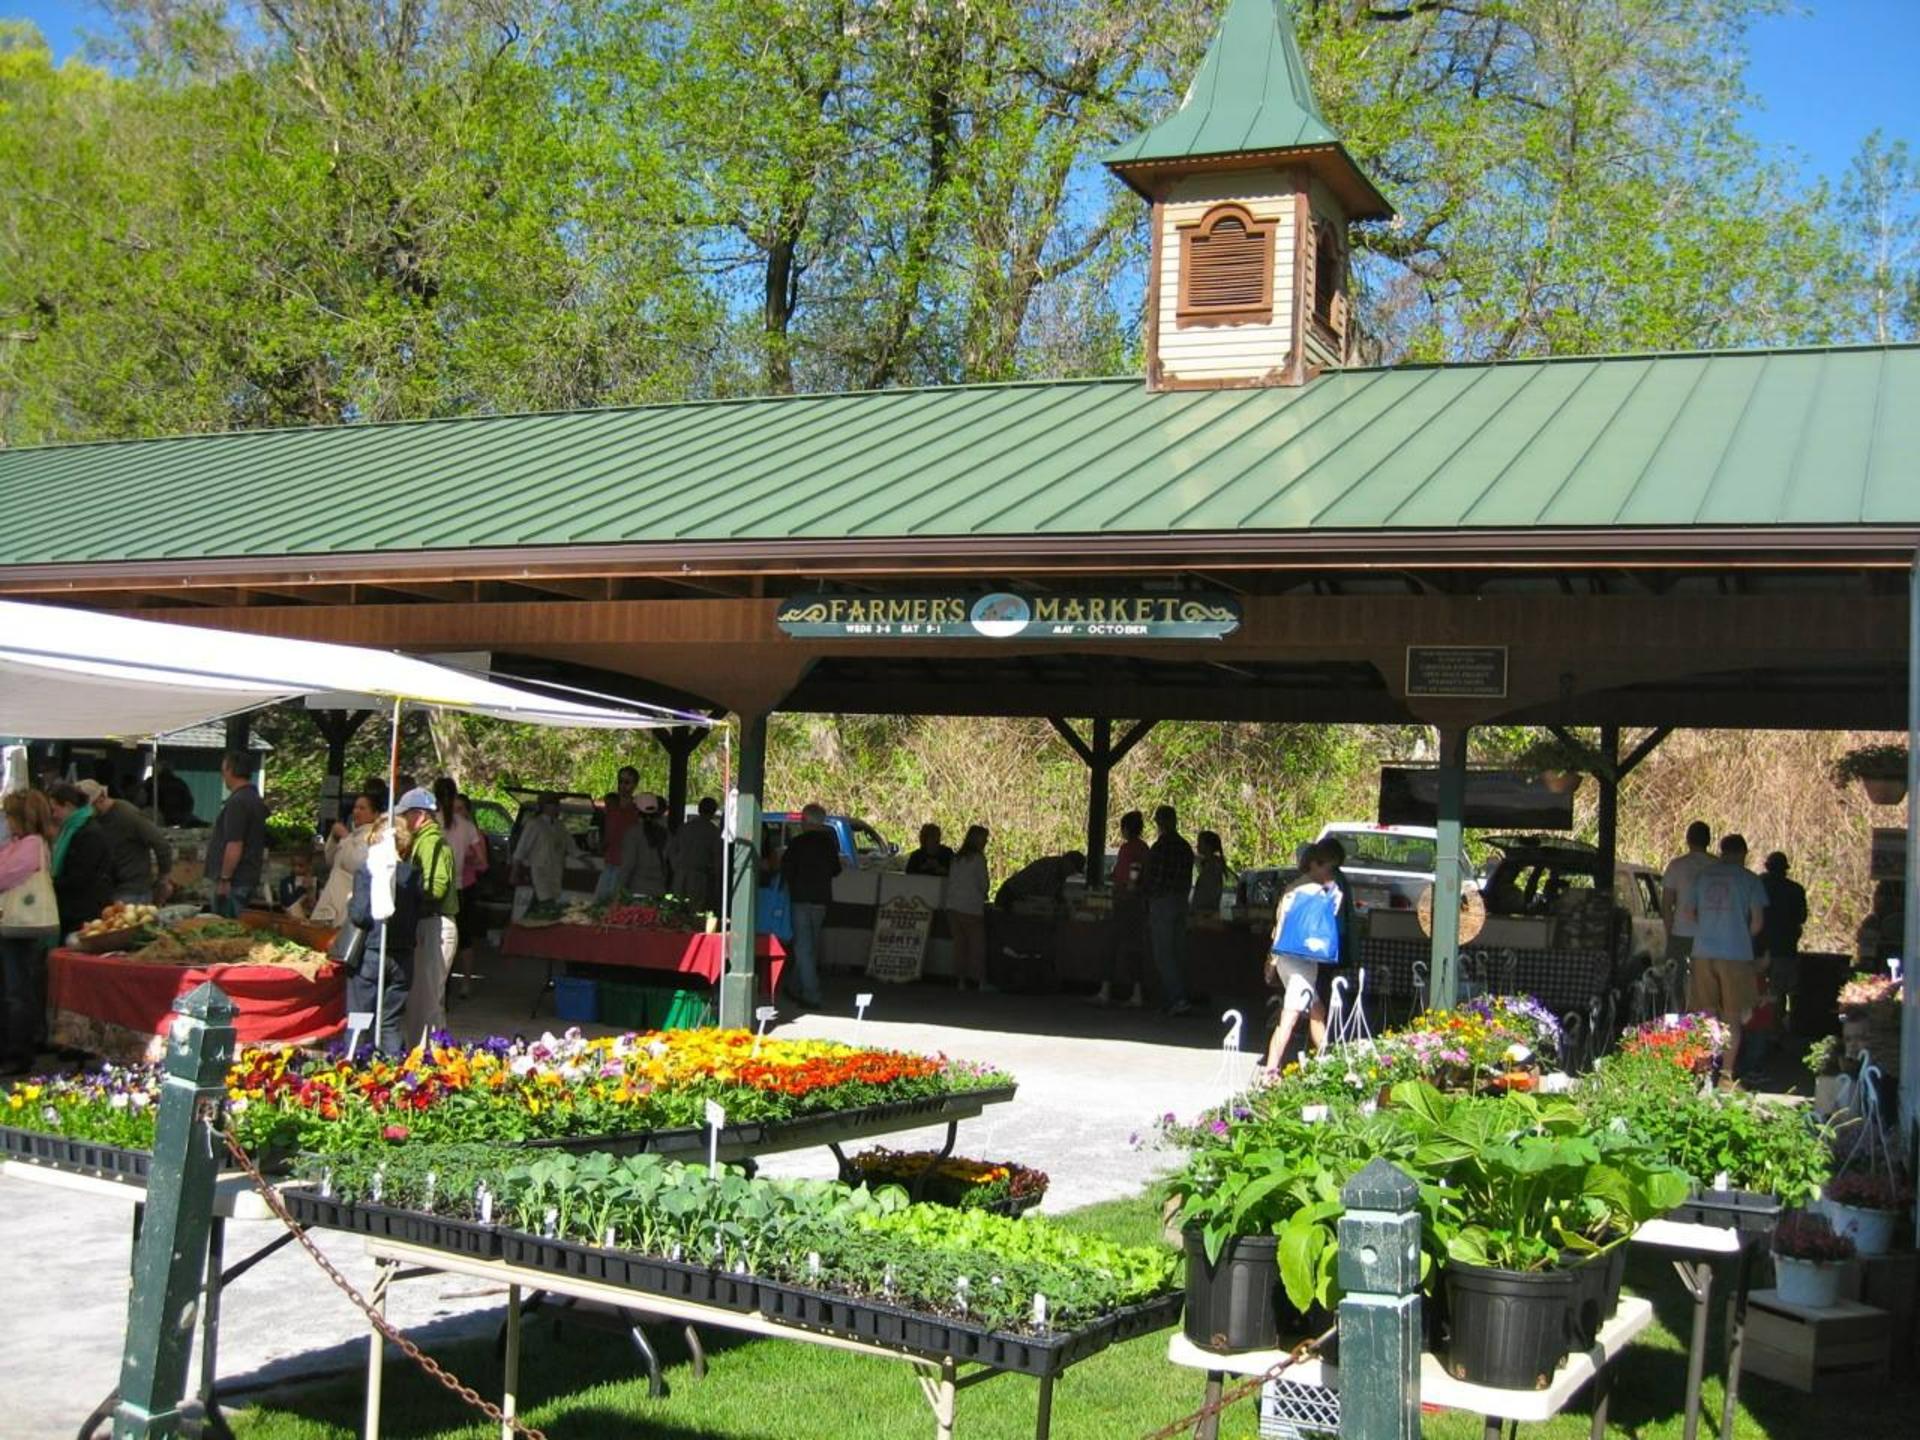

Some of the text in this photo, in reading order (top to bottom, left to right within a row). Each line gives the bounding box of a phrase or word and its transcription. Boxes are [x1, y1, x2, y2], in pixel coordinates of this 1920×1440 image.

[829, 597, 1180, 624] FARMER'S MARKET
[901, 624, 919, 634] SAT
[1052, 624, 1074, 635] MAY
[1087, 624, 1148, 635] OCTOBER
